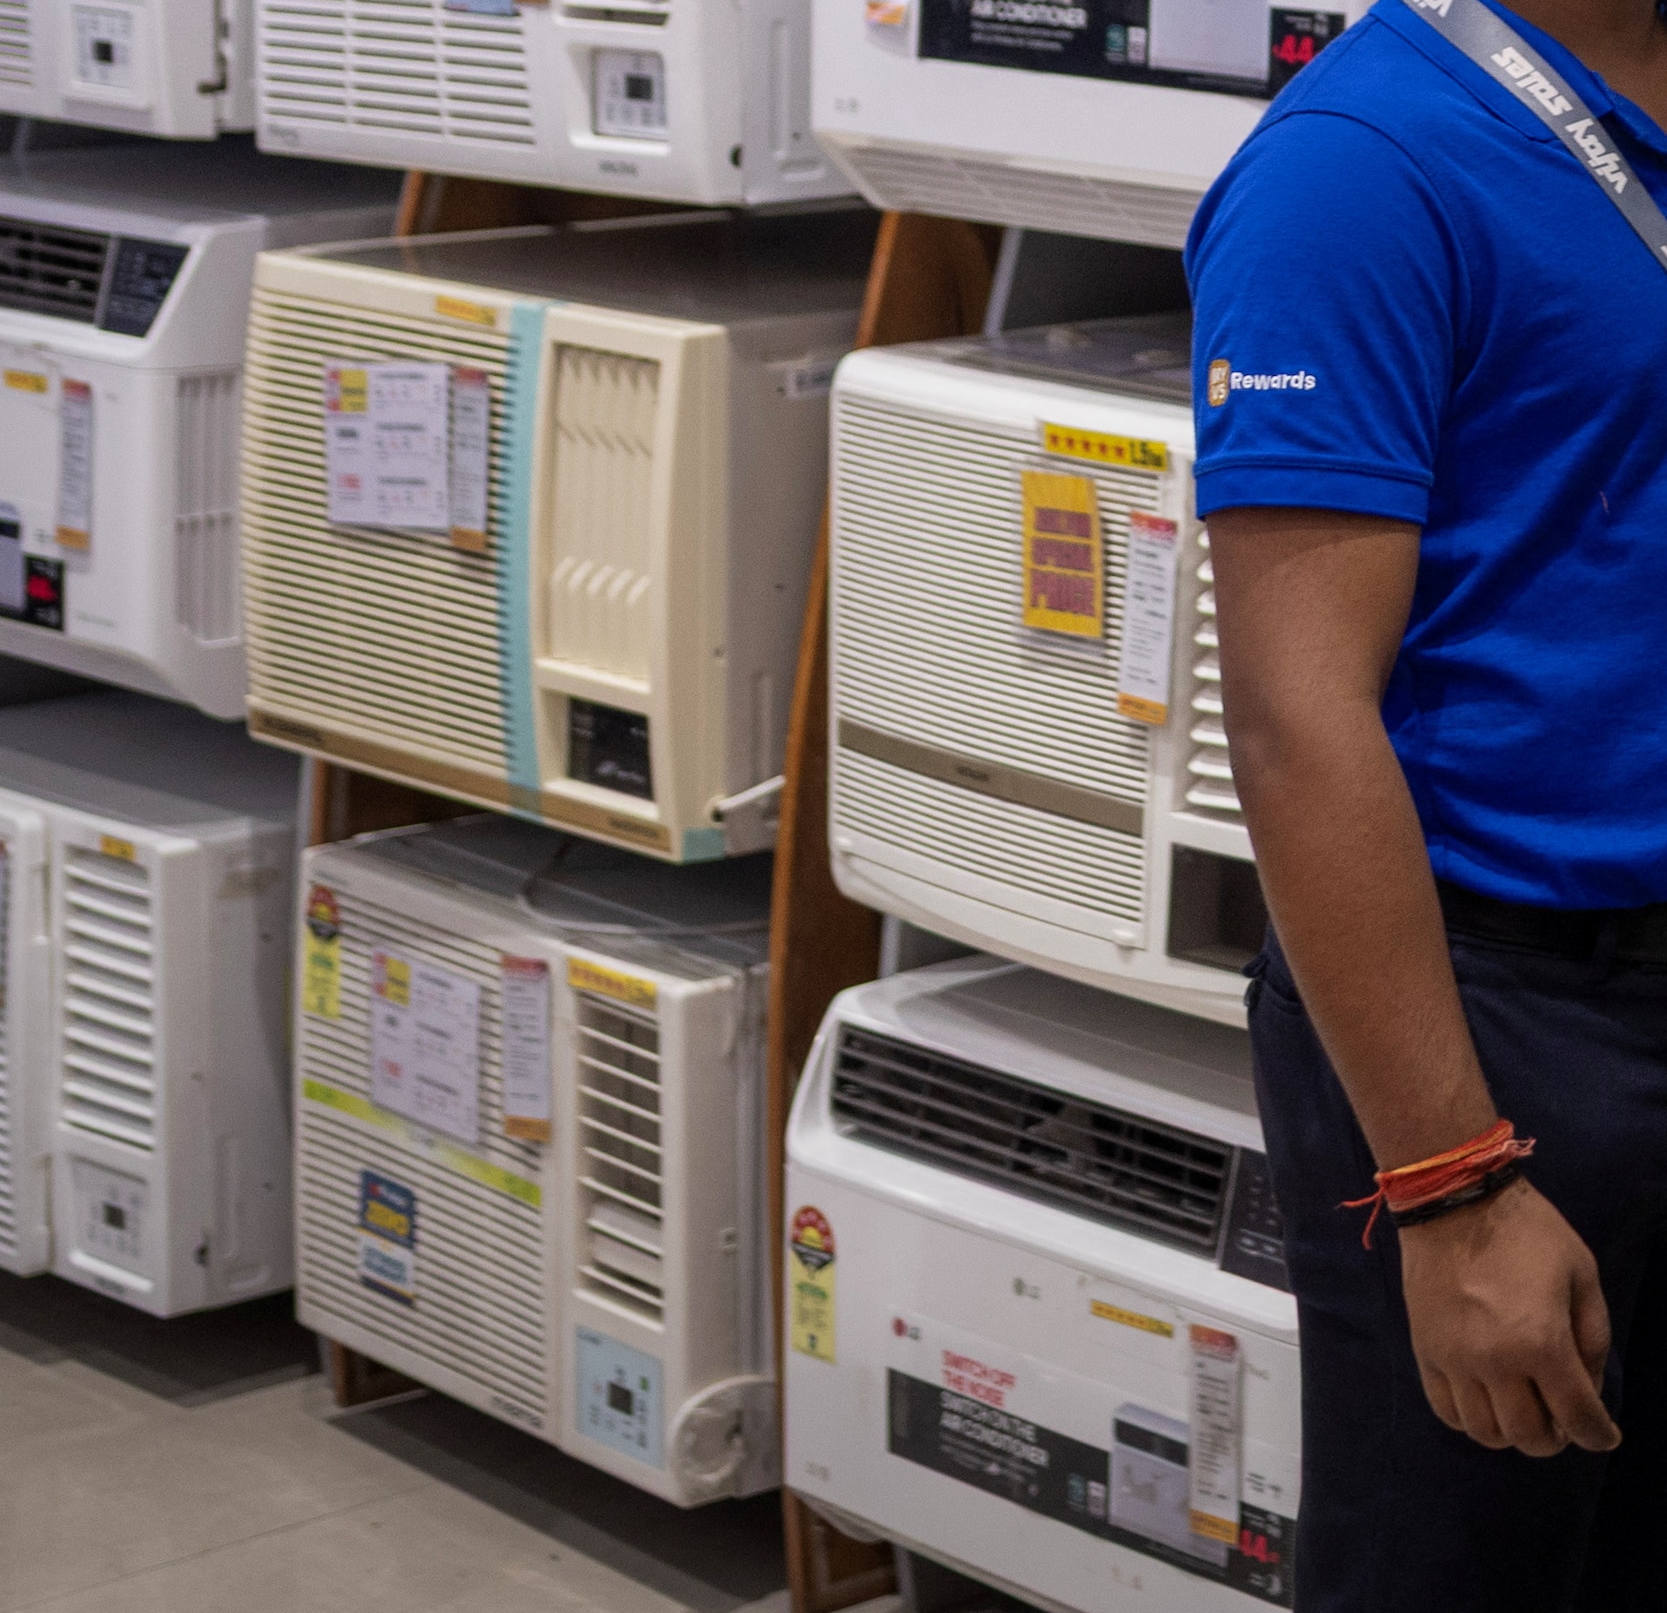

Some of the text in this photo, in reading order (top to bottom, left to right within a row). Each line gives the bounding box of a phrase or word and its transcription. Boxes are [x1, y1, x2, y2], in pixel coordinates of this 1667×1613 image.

[1490, 46, 1573, 117] sales
[1565, 117, 1629, 196] vijay
[1230, 370, 1317, 391] Rewards
